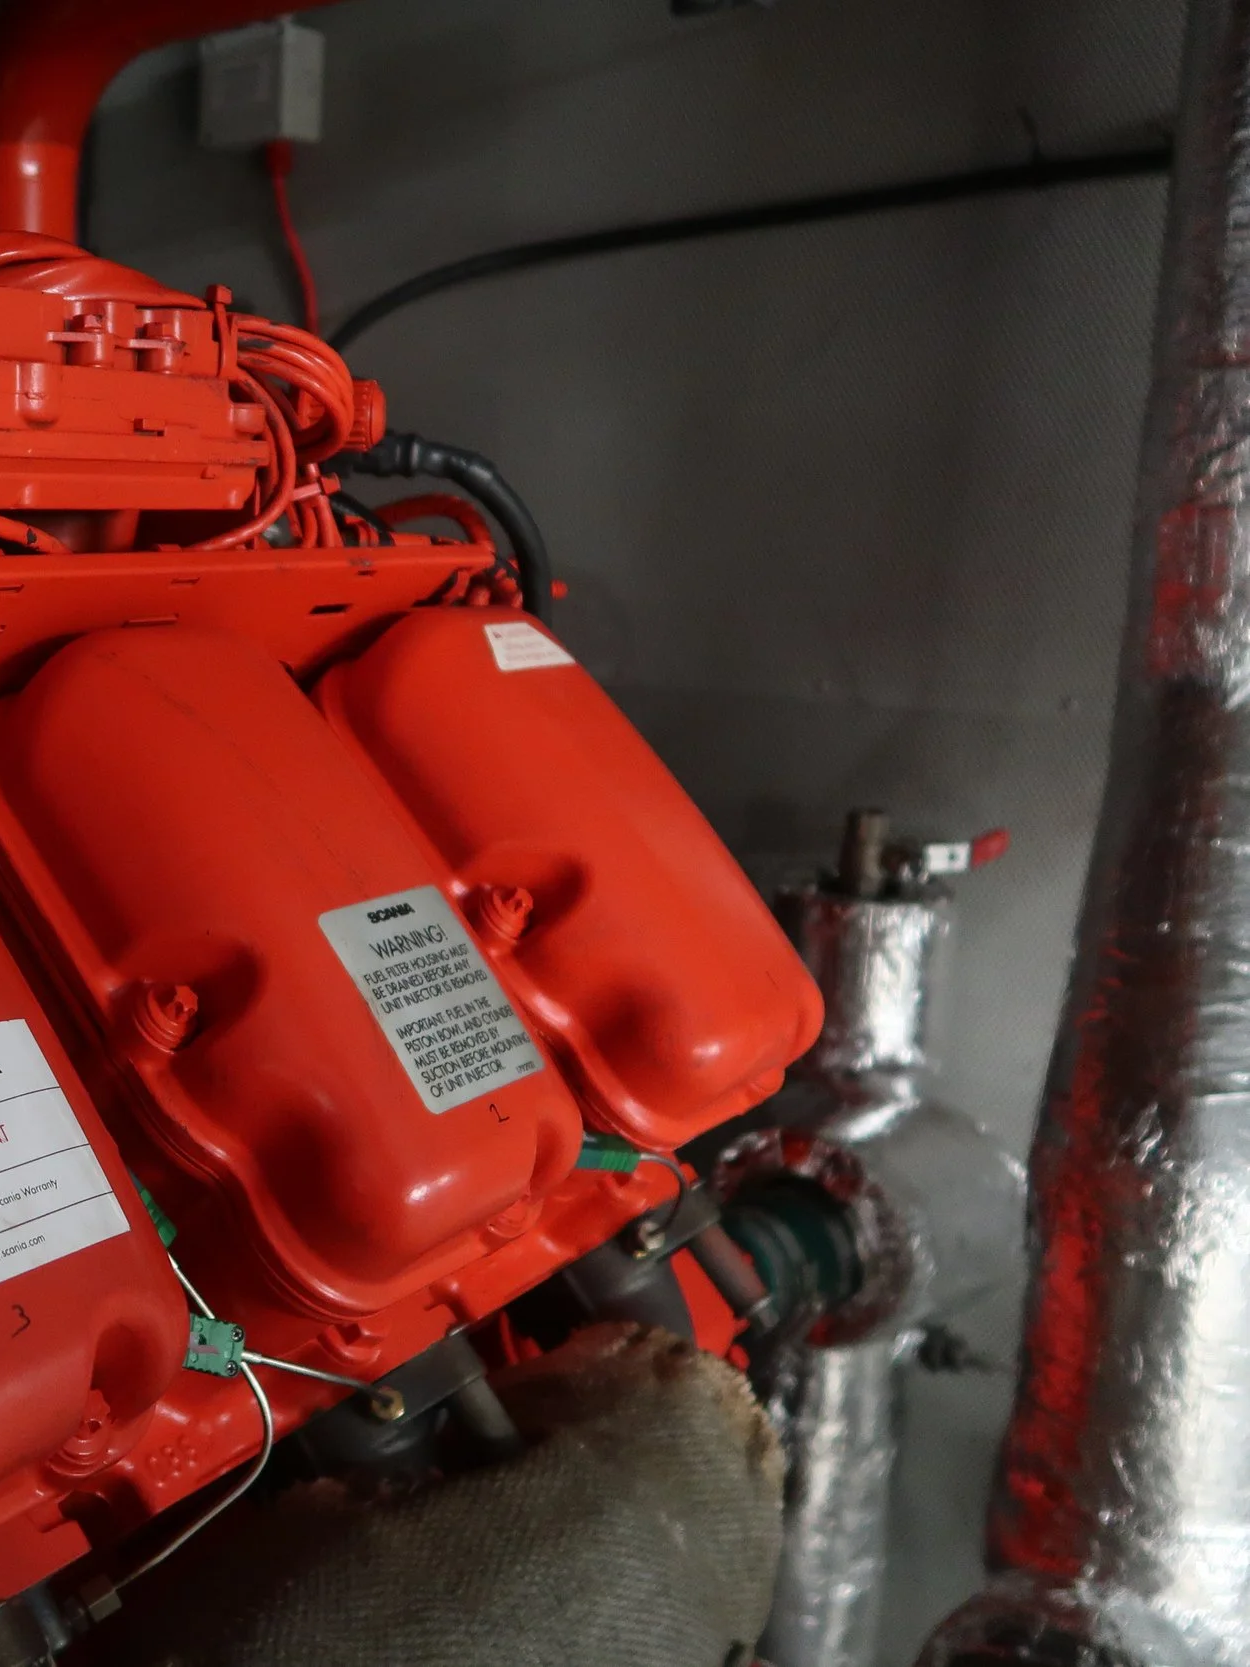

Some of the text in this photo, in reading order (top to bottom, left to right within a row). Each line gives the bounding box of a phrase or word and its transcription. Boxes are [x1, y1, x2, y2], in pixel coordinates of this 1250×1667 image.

[367, 902, 416, 924] SCANIA
[368, 923, 448, 960] WARNING!
[364, 943, 469, 986] FUEL FILTER HOUSING MUST
[372, 958, 471, 1000] BE DRAINED BEFORE ANY
[381, 968, 488, 1014] UNIT INJECTOR IS REMOVED
[445, 1004, 467, 1021] FUEL
[464, 1000, 477, 1014] IN
[474, 996, 491, 1010] THE
[405, 1032, 439, 1055] PISTON
[436, 1023, 465, 1042] BOWL
[464, 1016, 483, 1032] AND
[414, 1026, 500, 1070] MUST BE REMOVED BY
[421, 1058, 462, 1084] SUCTION
[459, 1046, 492, 1068] BEFORE
[490, 1031, 530, 1057] MOUNTING
[430, 1082, 445, 1098] OF
[443, 1073, 467, 1092] UNIT
[20, 1178, 58, 1198] Warranty
[11, 1303, 31, 1339] 3
